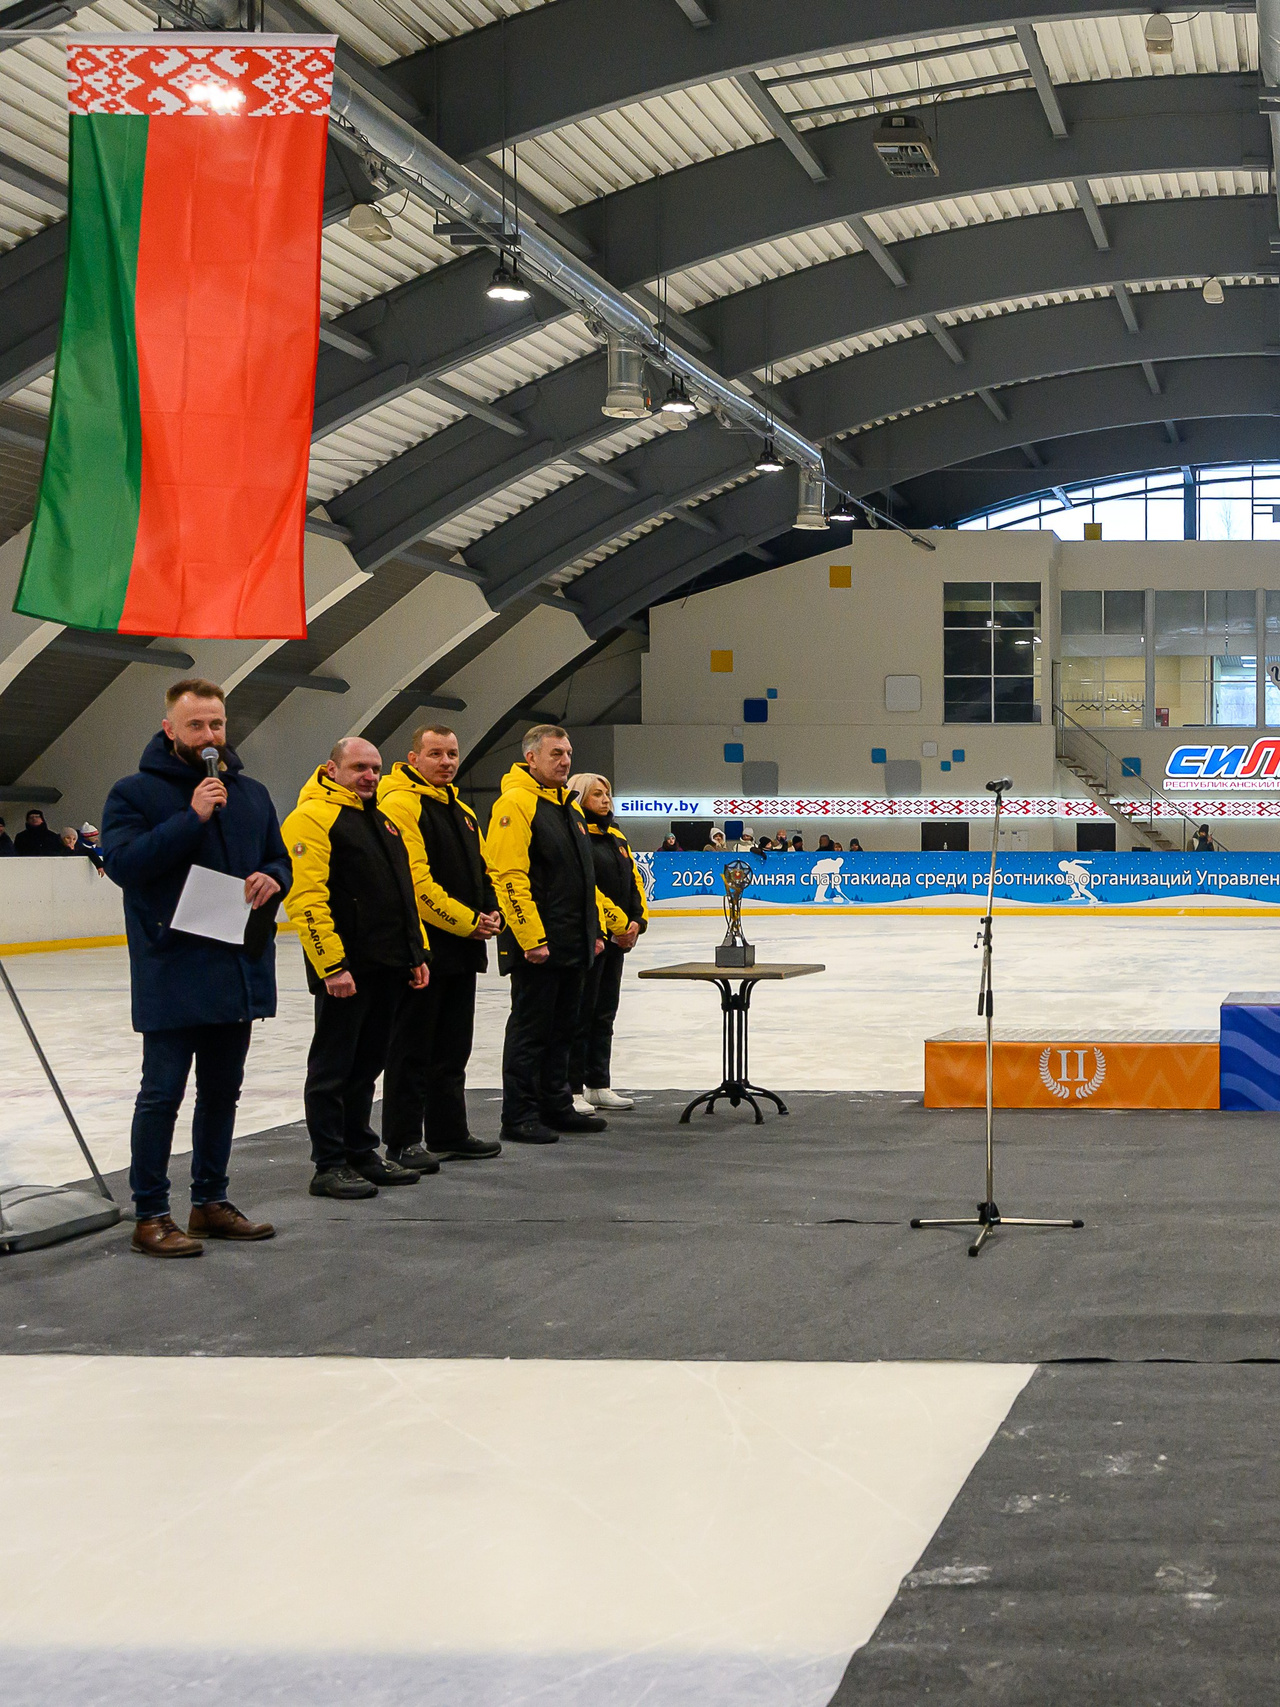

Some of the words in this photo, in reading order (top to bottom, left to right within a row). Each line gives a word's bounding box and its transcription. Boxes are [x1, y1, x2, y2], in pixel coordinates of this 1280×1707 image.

[1165, 779, 1275, 788] РЕСПУБЛИКАНСКИЙ
[621, 800, 699, 814] silichy.by
[672, 870, 714, 887] 2026
[800, 871, 911, 888] спартакиада
[915, 871, 967, 888] среди
[972, 868, 1075, 889] работников
[1079, 868, 1192, 889] организаций
[420, 894, 458, 926] BELARUS
[506, 882, 526, 925] BELARUS
[304, 910, 325, 956] BELARUS
[1056, 1050, 1088, 1081] II
